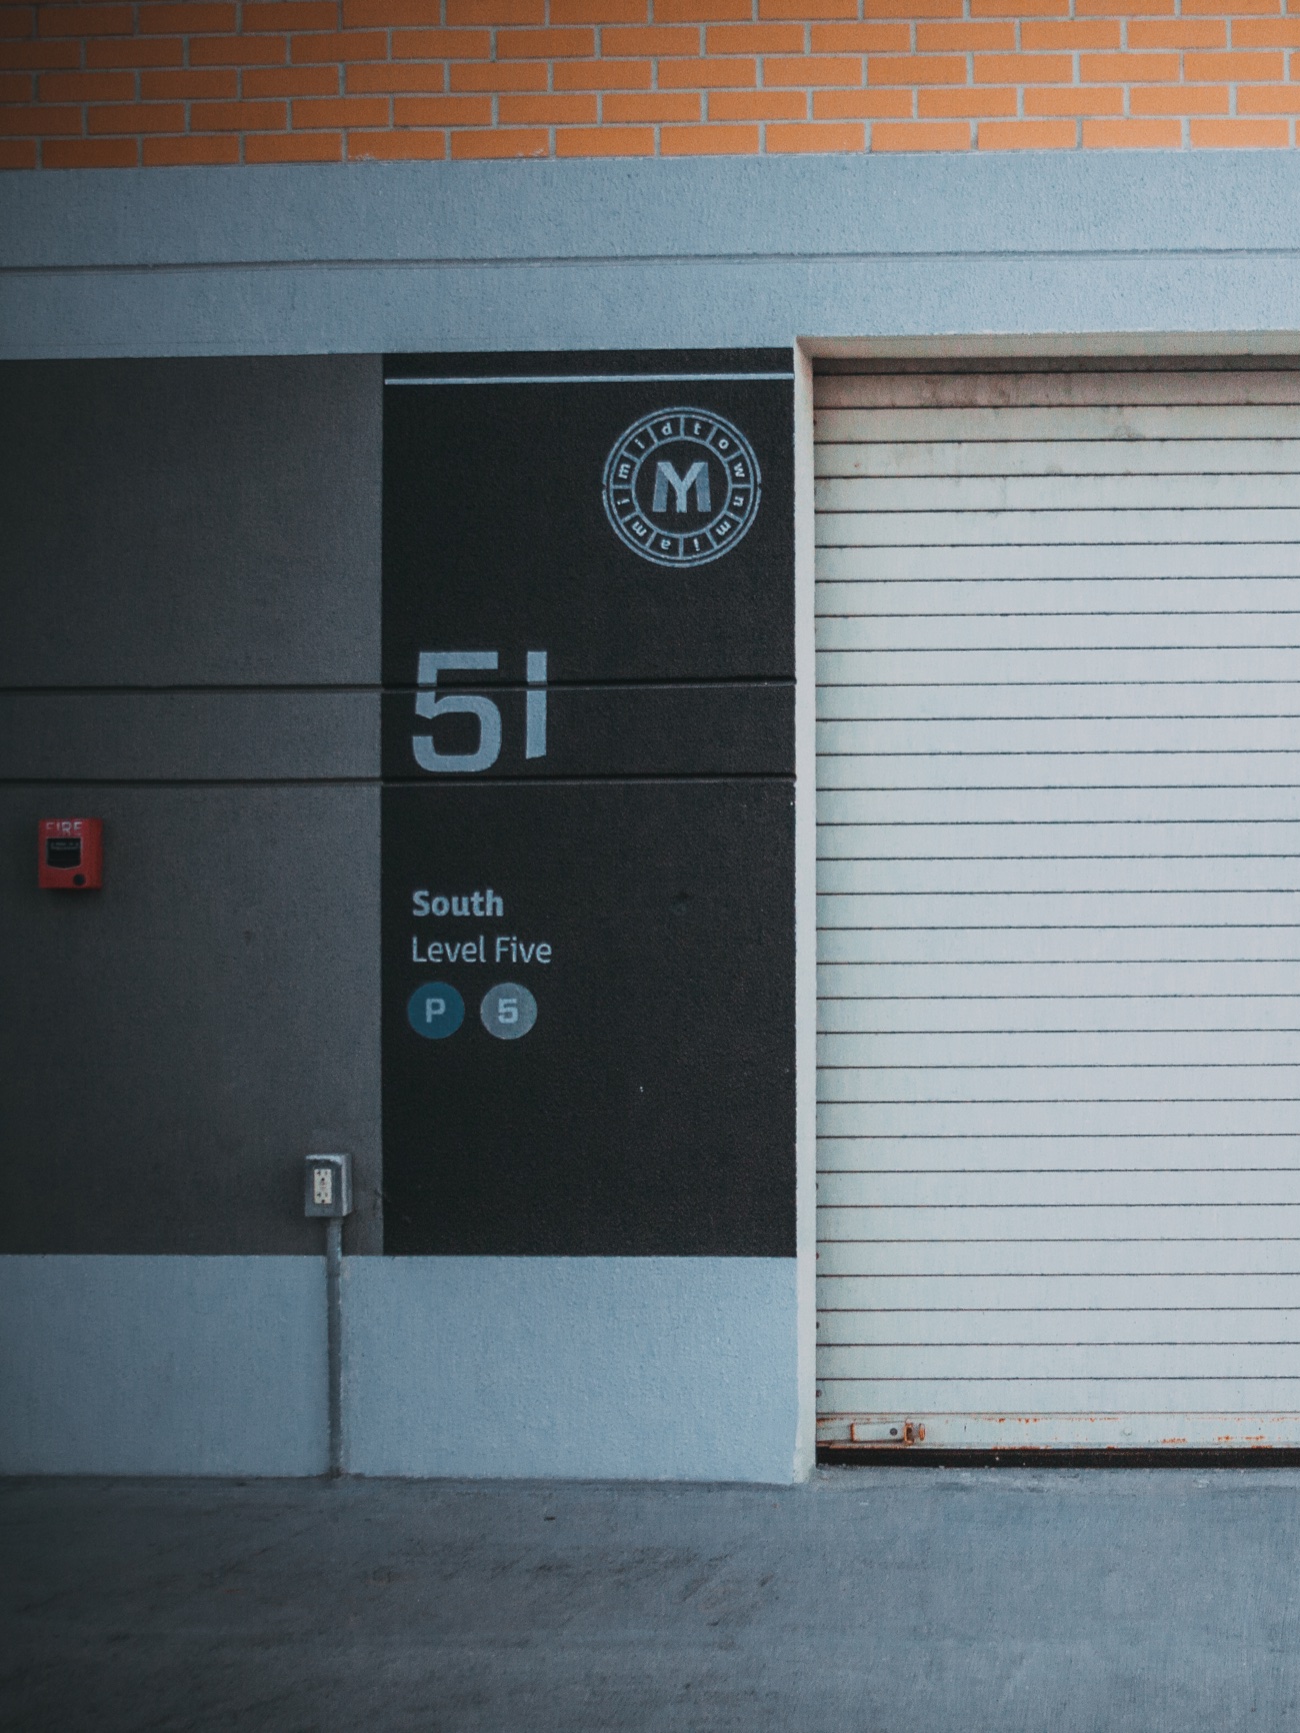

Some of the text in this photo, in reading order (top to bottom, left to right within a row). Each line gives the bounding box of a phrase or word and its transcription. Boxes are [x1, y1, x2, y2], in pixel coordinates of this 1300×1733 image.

[618, 422, 746, 507] midtown
[412, 889, 504, 917] South
[412, 936, 552, 964] Level Five
[426, 999, 519, 1024] P 5
